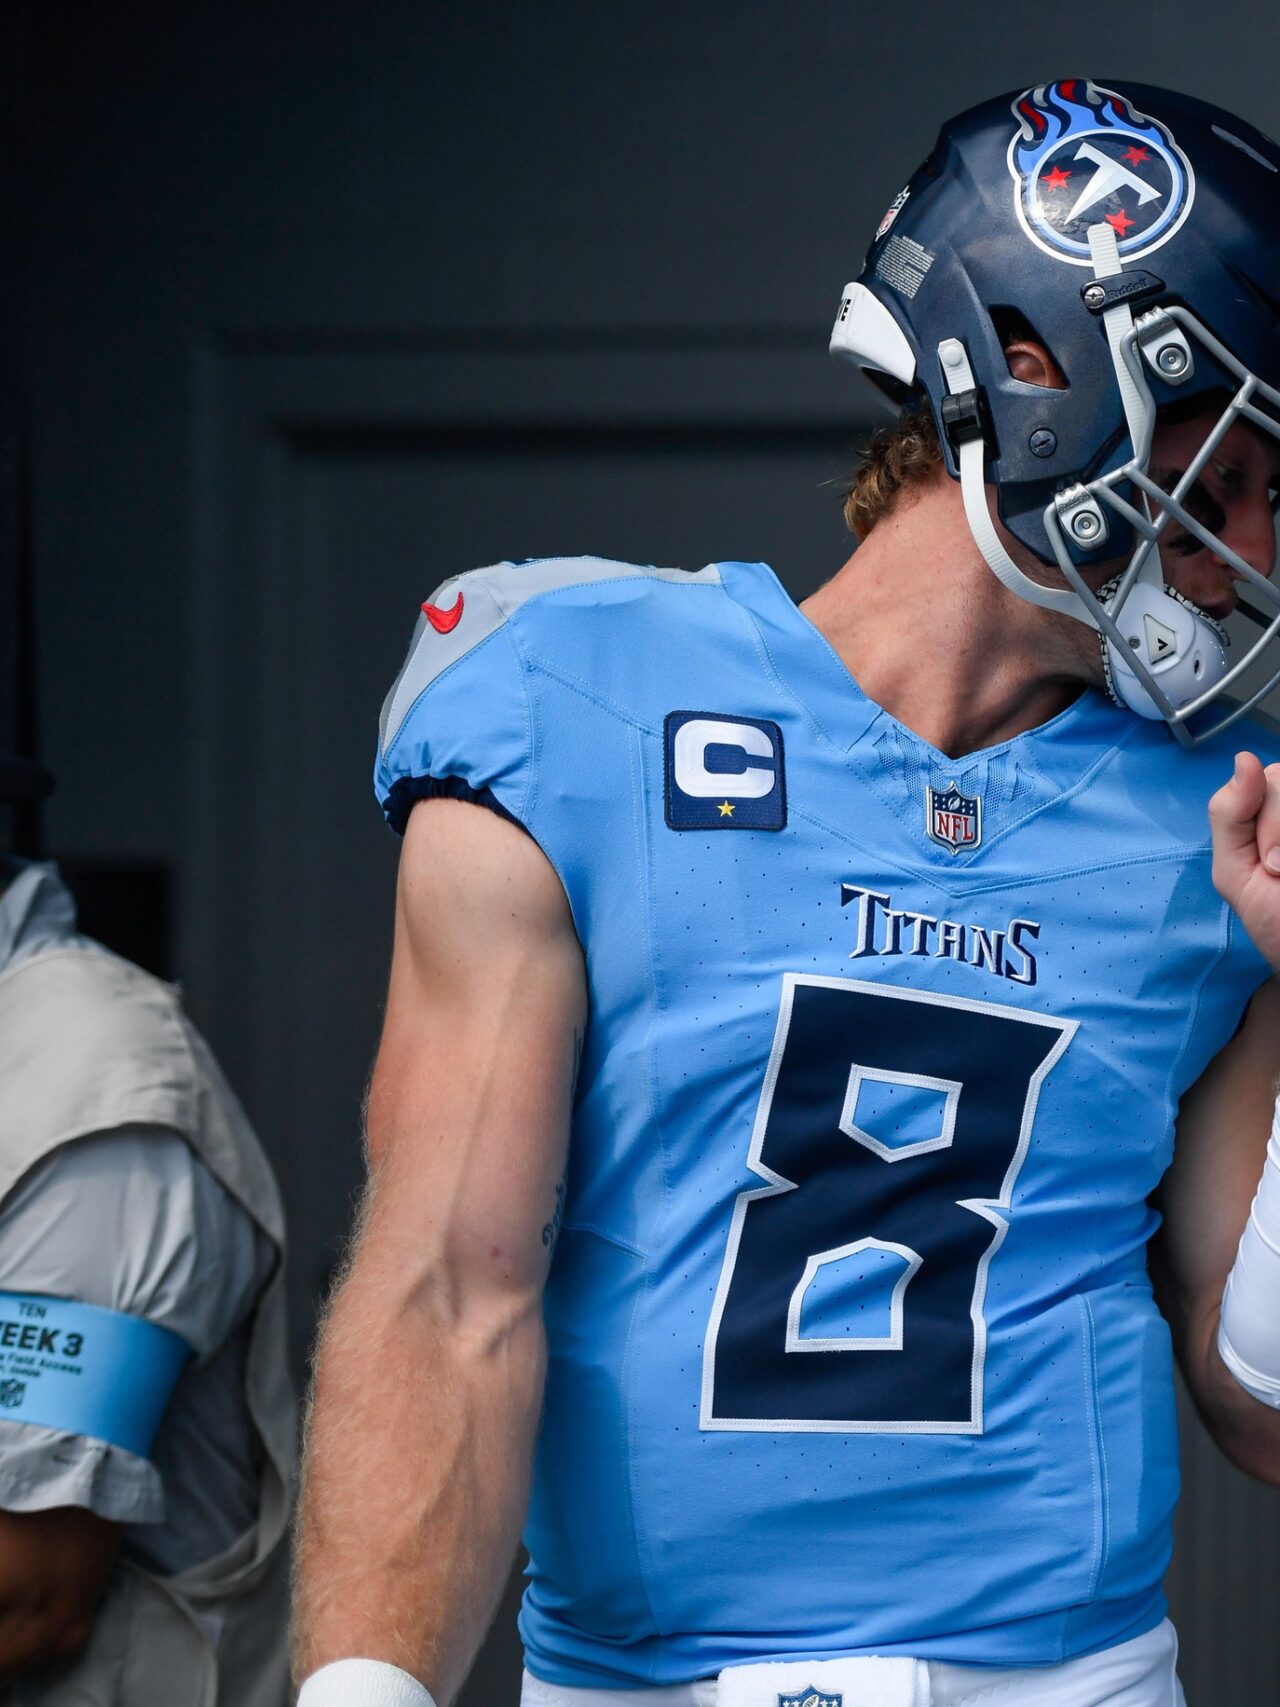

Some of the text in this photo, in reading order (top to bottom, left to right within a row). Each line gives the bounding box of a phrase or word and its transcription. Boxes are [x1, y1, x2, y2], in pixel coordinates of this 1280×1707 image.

[674, 719, 775, 798] C
[937, 811, 974, 842] NFL
[840, 883, 1041, 987] TITANS
[699, 972, 1081, 1435] 8
[18, 1302, 47, 1318] TEN
[62, 1333, 84, 1357] 3
